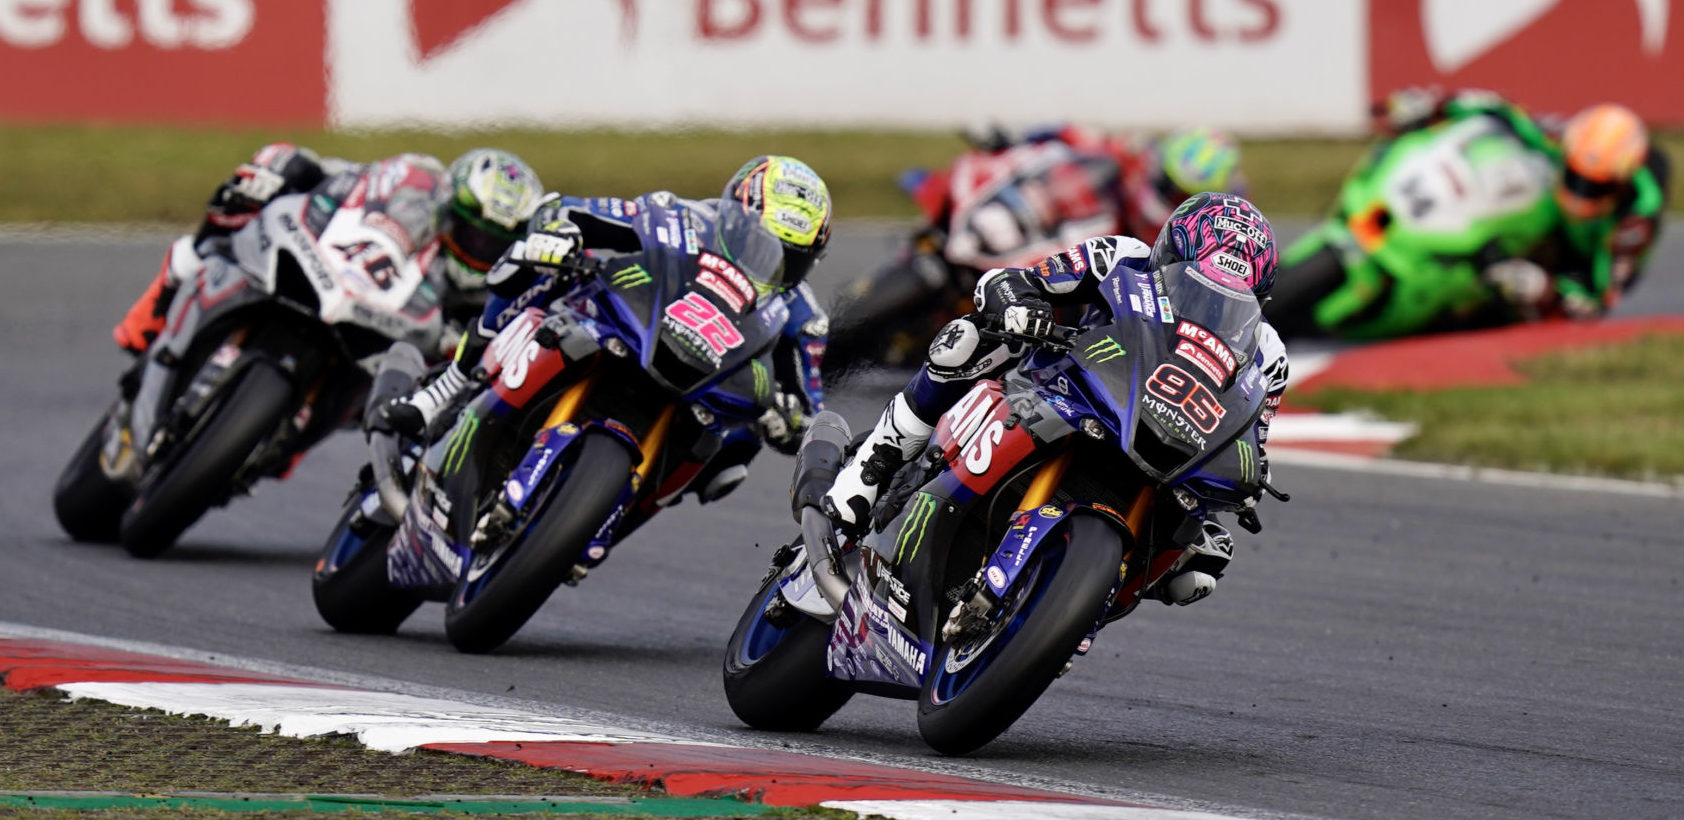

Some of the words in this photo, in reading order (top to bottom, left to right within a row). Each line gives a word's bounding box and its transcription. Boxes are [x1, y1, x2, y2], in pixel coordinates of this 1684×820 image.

[1217, 255, 1248, 276] SHOEI
[665, 291, 745, 356] 22
[1179, 322, 1236, 373] McAMS
[1195, 351, 1225, 380] Bennetts
[1141, 394, 1207, 451] MONSTER
[1145, 363, 1227, 434] 95
[887, 624, 927, 675] YAMAHA
